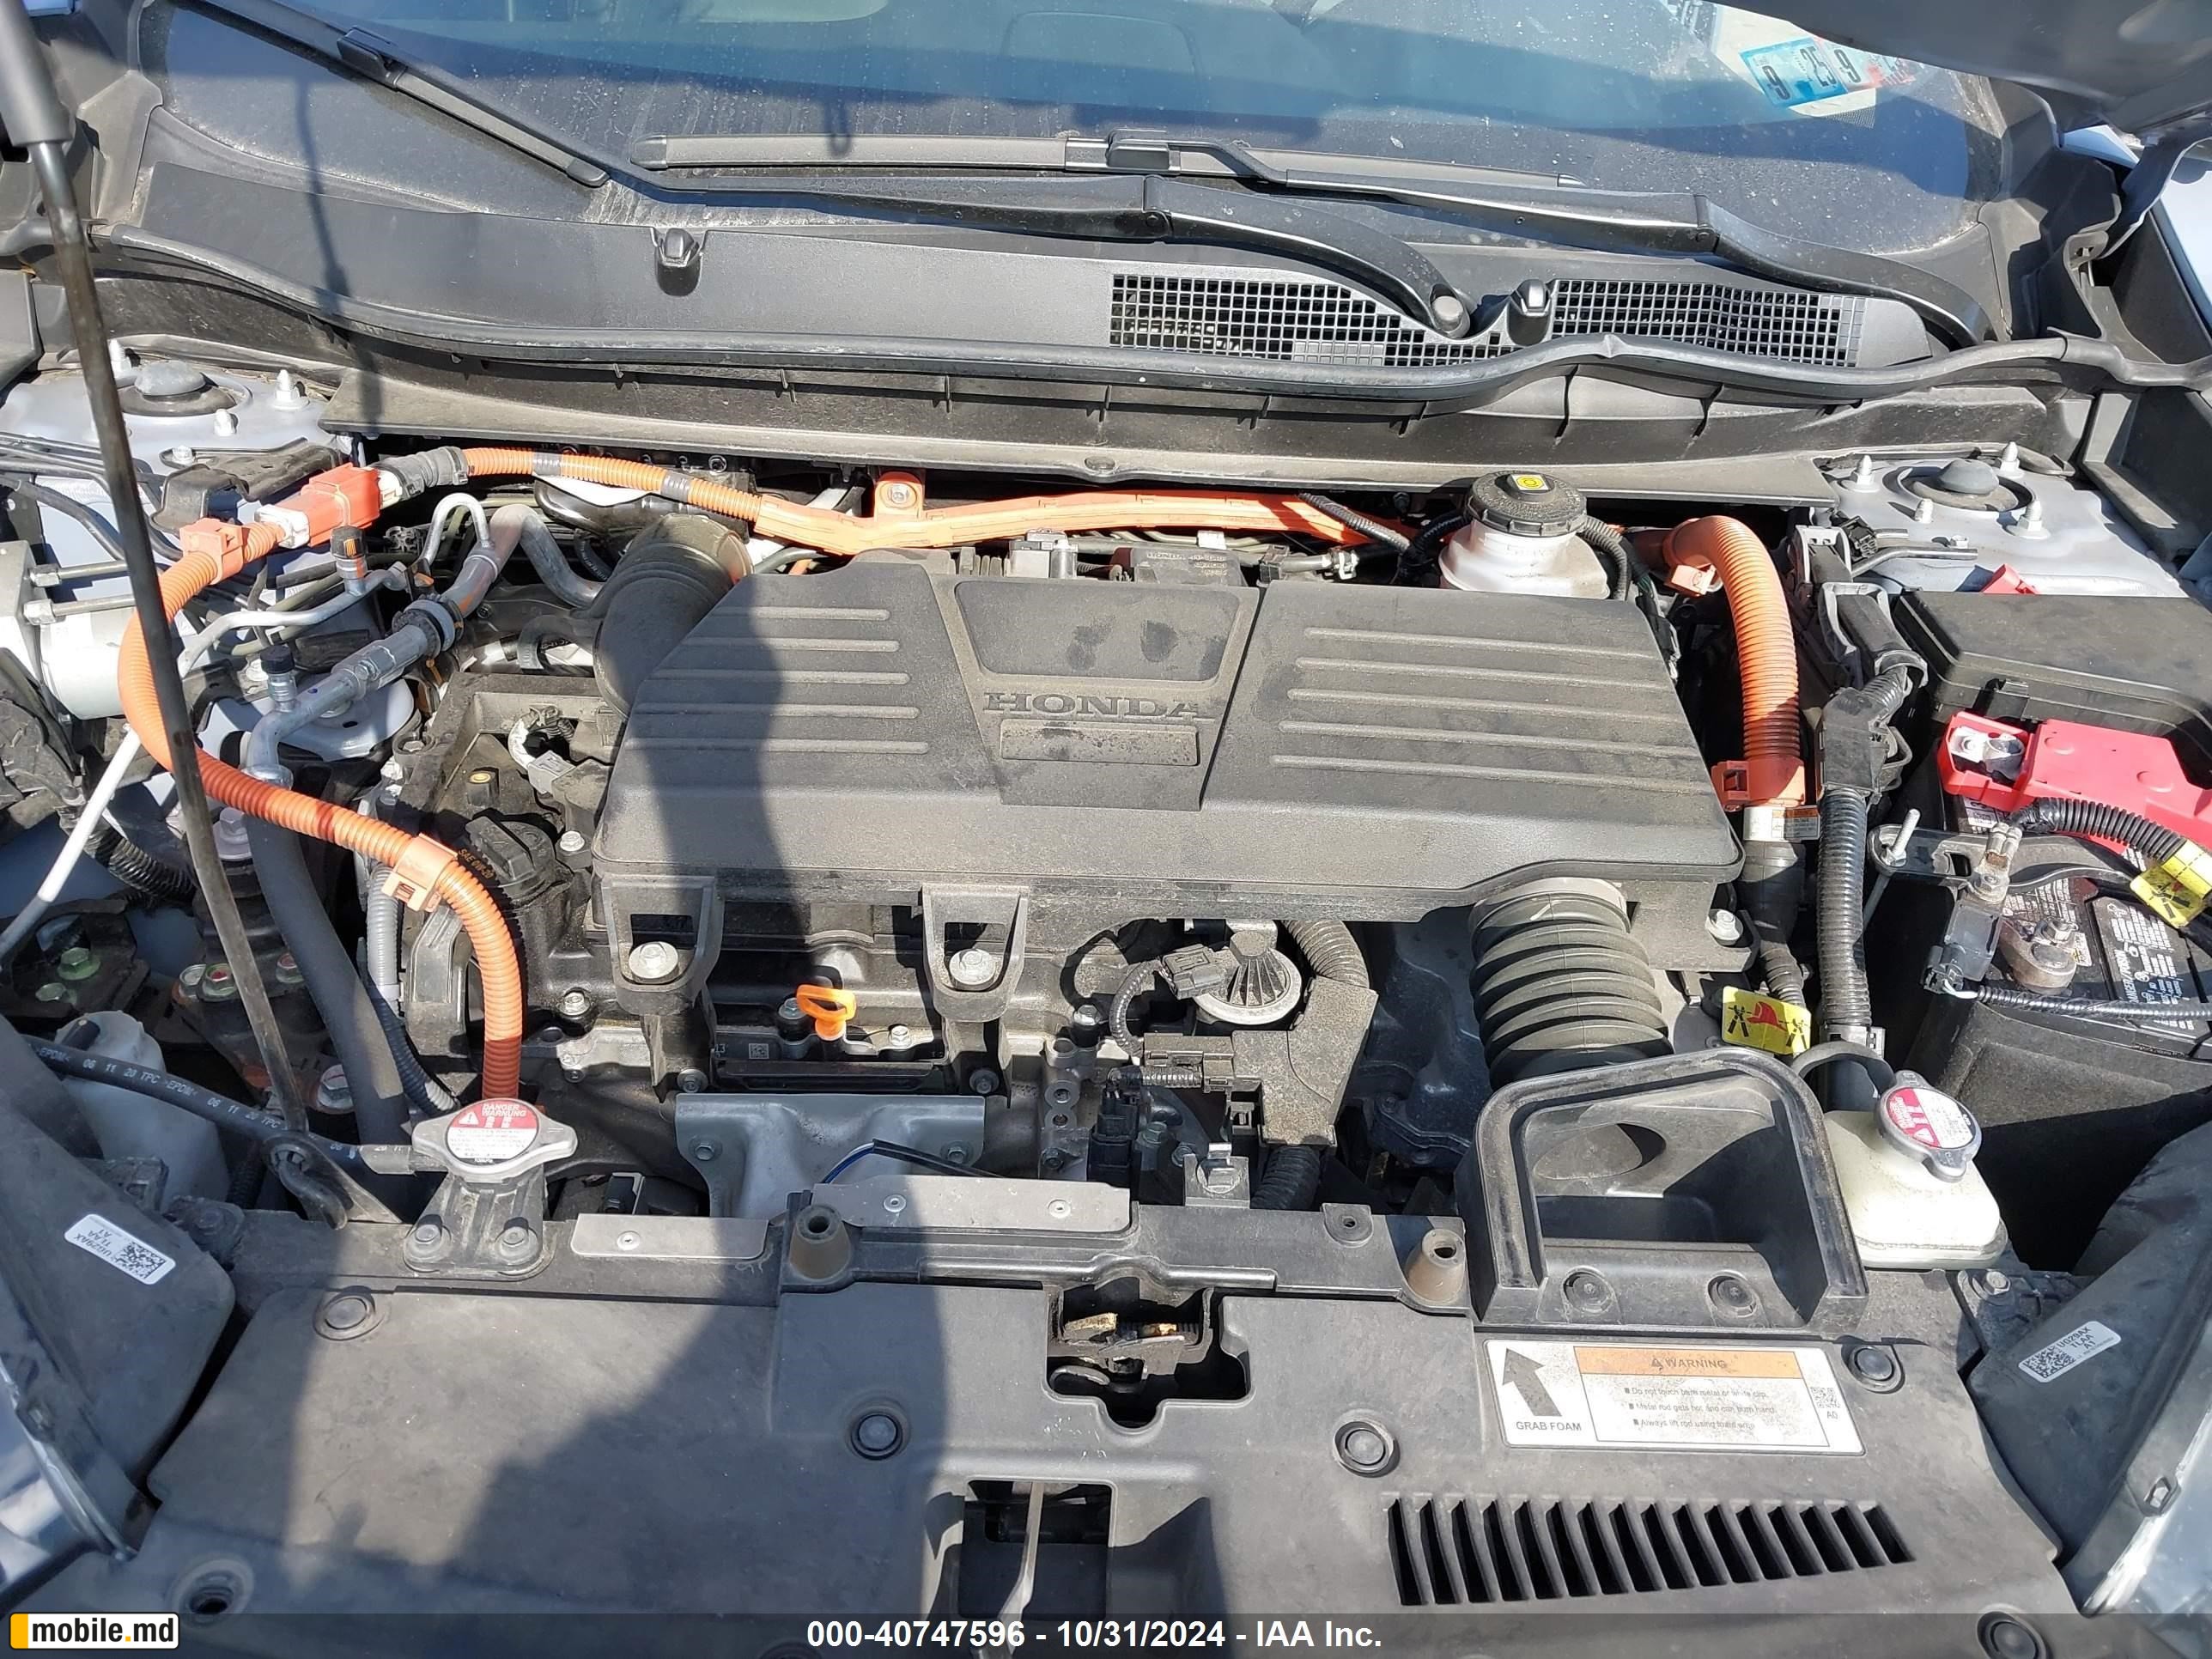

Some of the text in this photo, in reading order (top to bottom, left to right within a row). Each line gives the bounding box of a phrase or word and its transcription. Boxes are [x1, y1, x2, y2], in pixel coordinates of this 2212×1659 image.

[1800, 46, 1837, 88] 25
[983, 692, 1214, 721] HONDA
[459, 848, 476, 862] SAE
[105, 1062, 118, 1073] 11
[140, 1071, 161, 1084] TPC
[227, 1104, 240, 1114] 11
[260, 1116, 282, 1129] TPC
[1665, 1358, 1728, 1370] WARNING
[1658, 1388, 1680, 1396] touch
[1636, 1402, 1657, 1411] Metal
[1673, 1404, 1690, 1413] gets
[1516, 1421, 1582, 1432] GRAB FOAM
[1641, 1419, 1668, 1429] Always
[1669, 1419, 1680, 1427] lift
[1680, 1419, 1693, 1427] rod
[1694, 1420, 1716, 1430] using
